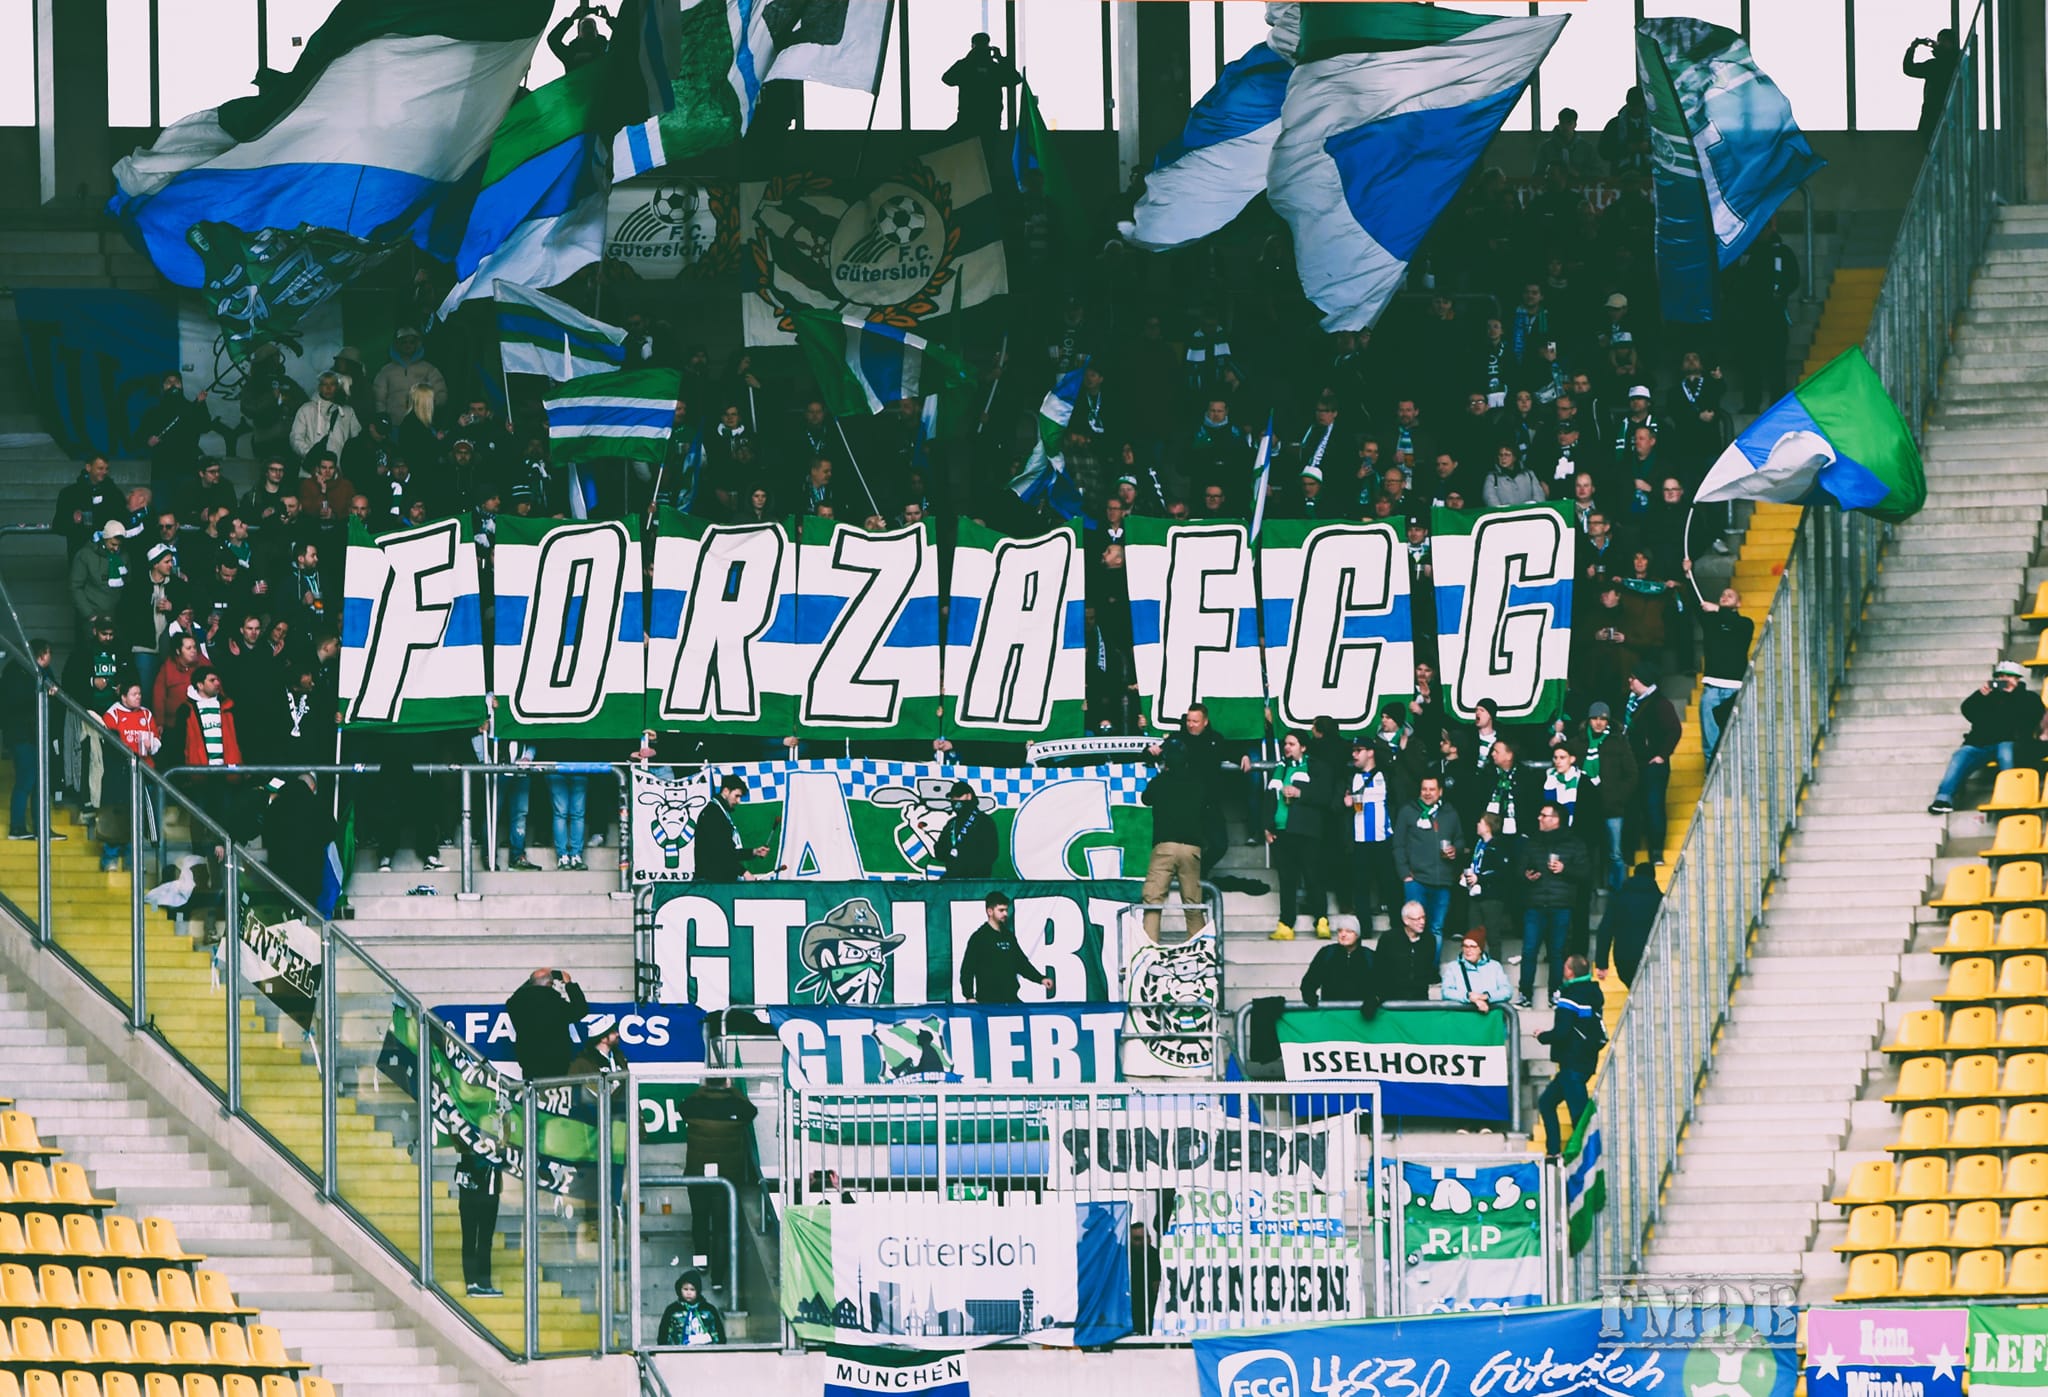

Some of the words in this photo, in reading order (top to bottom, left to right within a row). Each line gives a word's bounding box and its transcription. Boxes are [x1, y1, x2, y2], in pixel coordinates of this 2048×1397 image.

[835, 262, 931, 283] Gütersloh
[898, 244, 934, 264] F.C.
[345, 517, 1077, 732] FORZA
[1150, 507, 1562, 734] FCG
[634, 773, 708, 788] VECCHIA
[654, 895, 808, 1010] GT
[466, 1010, 670, 1047] FACS
[778, 1017, 875, 1090] GT
[947, 1012, 1125, 1088] LEBT
[1302, 1050, 1487, 1078] ISSELHORST
[1062, 1125, 1331, 1181] SUNDERN
[877, 1233, 1037, 1270] Gütersloh
[1429, 1225, 1502, 1256] R.I.P
[1165, 1265, 1351, 1314] MINDEN
[1971, 1332, 2048, 1374] LEF
[1233, 1376, 1290, 1397] FCG
[1311, 1355, 1451, 1397] 4830
